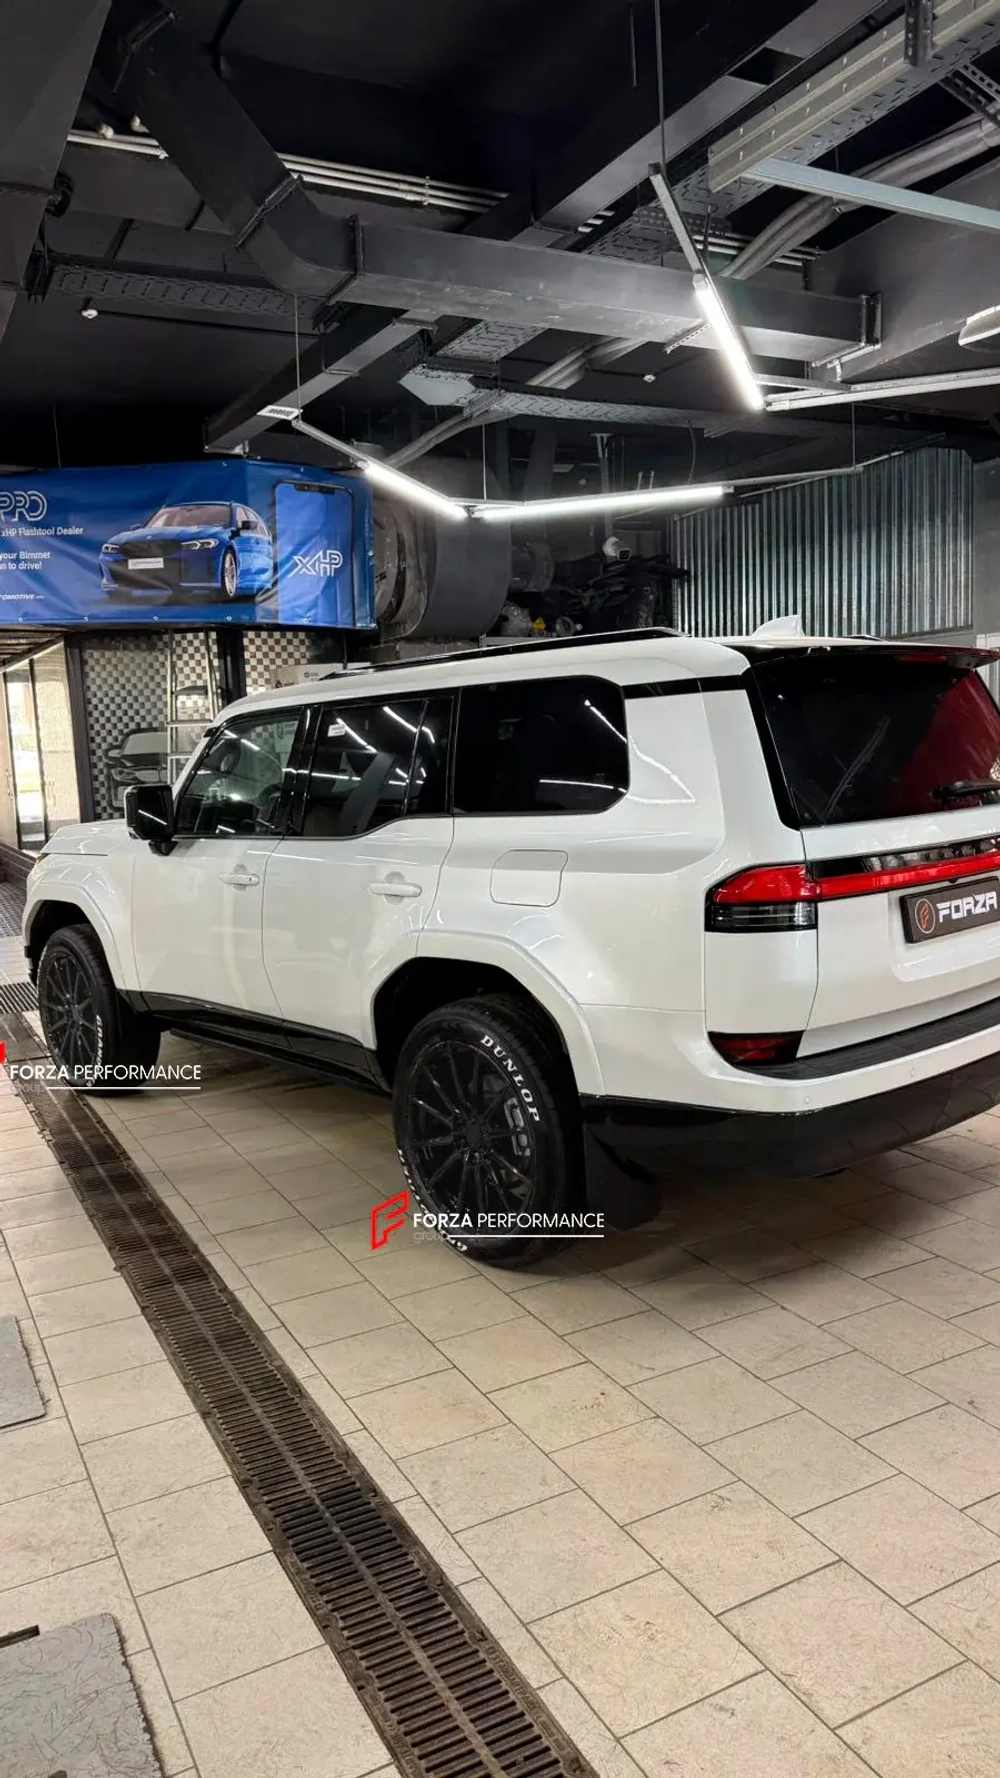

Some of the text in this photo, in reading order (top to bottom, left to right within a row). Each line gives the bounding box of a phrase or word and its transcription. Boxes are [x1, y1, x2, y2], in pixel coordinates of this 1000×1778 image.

[19, 527, 54, 536] Flashtool
[56, 526, 84, 535] Dealer
[19, 551, 51, 559] Bimmer
[18, 561, 43, 570] drive!
[936, 891, 998, 924] FORZA
[480, 1034, 540, 1121] DUNLOP
